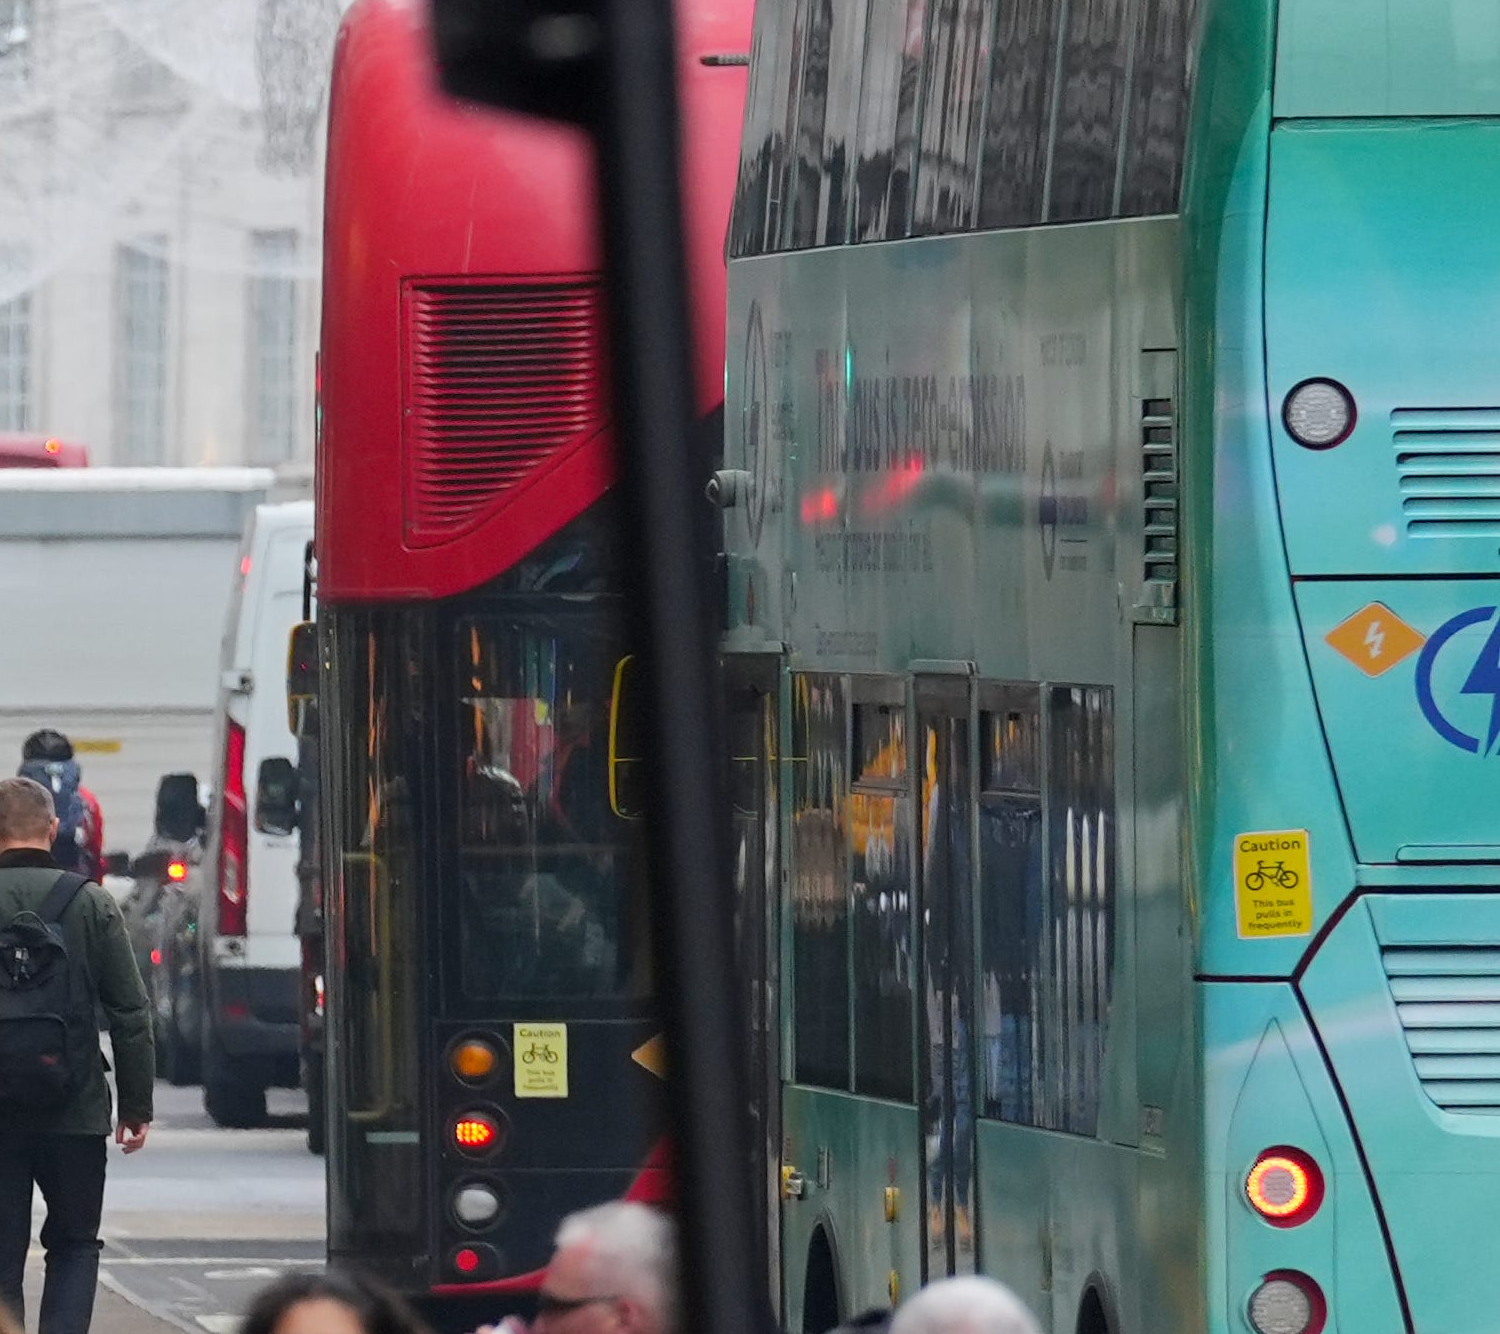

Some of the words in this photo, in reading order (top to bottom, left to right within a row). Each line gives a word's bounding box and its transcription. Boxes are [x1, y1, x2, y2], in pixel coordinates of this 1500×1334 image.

[1240, 839, 1301, 853] Caution
[1252, 899, 1275, 908] This
[1256, 910, 1281, 919] pulls
[1283, 909, 1293, 917] in
[1248, 920, 1302, 930] frequently
